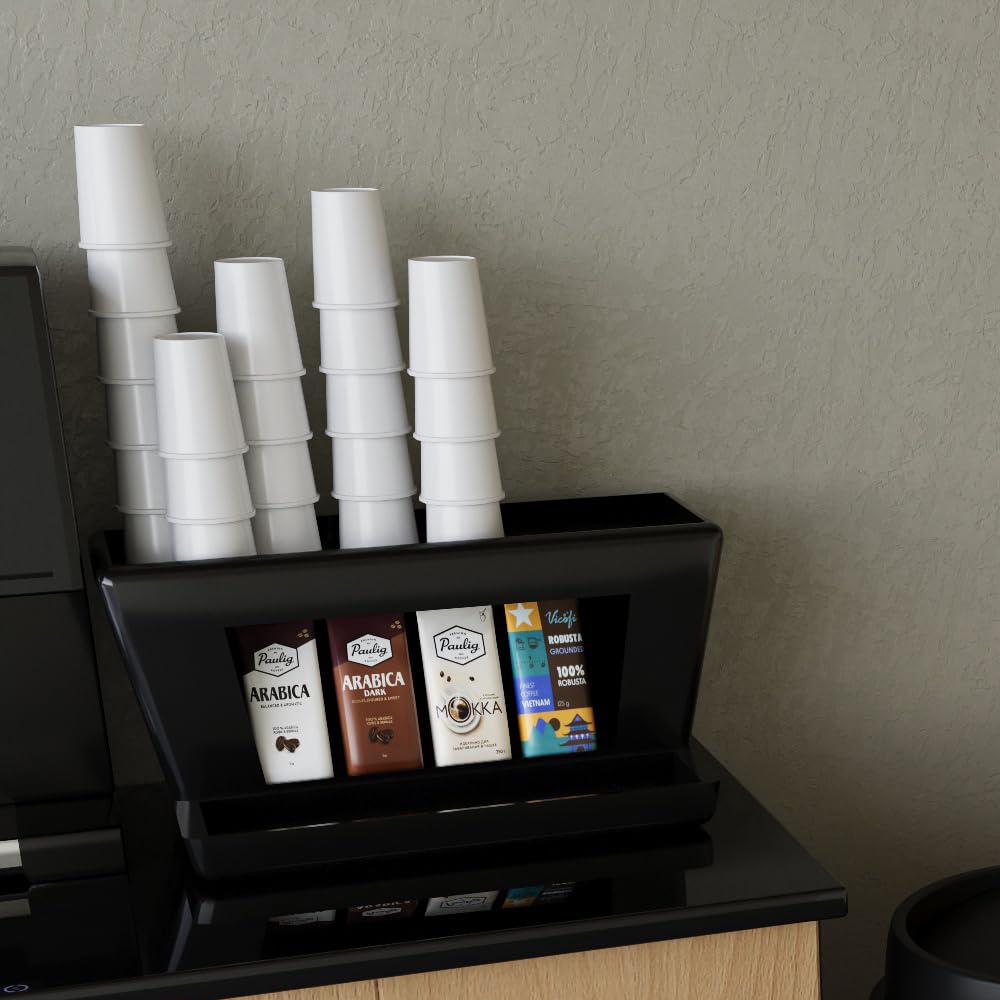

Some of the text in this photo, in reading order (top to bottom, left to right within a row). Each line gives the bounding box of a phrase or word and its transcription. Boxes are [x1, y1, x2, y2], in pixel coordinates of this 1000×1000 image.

[439, 637, 479, 654] Paulig
[548, 633, 583, 645] ROBUSTA
[351, 642, 387, 657] Paulig
[550, 646, 584, 655] GROUNDED
[258, 651, 294, 667] Paulig
[557, 664, 585, 678] 100%
[342, 671, 406, 691] ARABICA
[558, 677, 586, 687] ROBUSTA
[250, 683, 311, 703] ARABICA
[364, 688, 387, 697] DARK
[436, 697, 503, 723] MOKKA
[522, 698, 550, 708] VIETNAM
